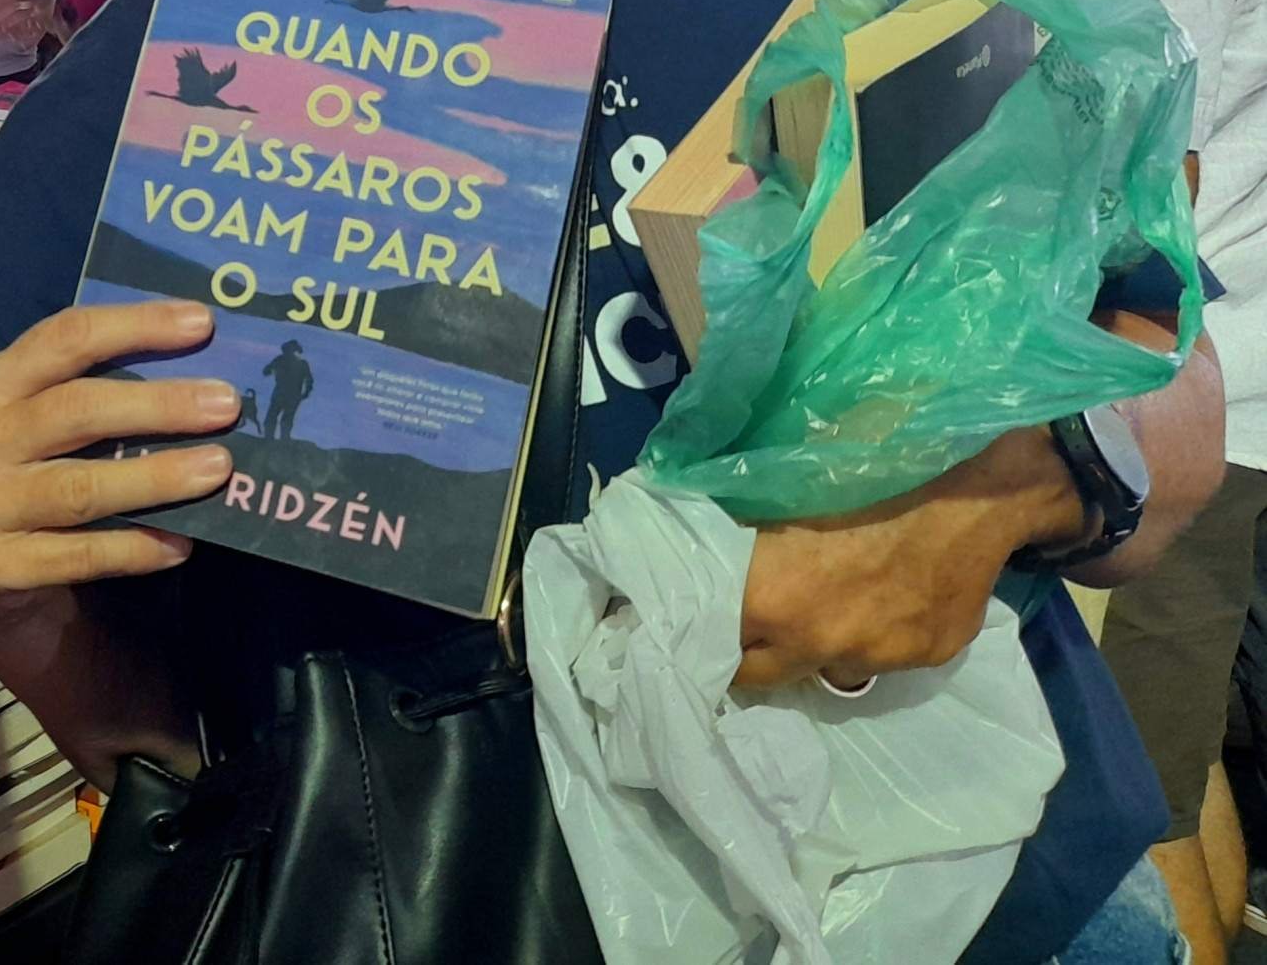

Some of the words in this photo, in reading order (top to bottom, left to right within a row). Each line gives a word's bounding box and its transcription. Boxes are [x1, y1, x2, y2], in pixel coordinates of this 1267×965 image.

[236, 11, 491, 86] QUANDO
[307, 84, 381, 134] OS
[180, 119, 483, 221] PÁSSAROS
[144, 180, 309, 254] VOAM
[333, 217, 503, 296] PARA
[211, 262, 257, 308] O
[287, 276, 385, 340] SUL
[224, 471, 406, 551] RIDZÉN
